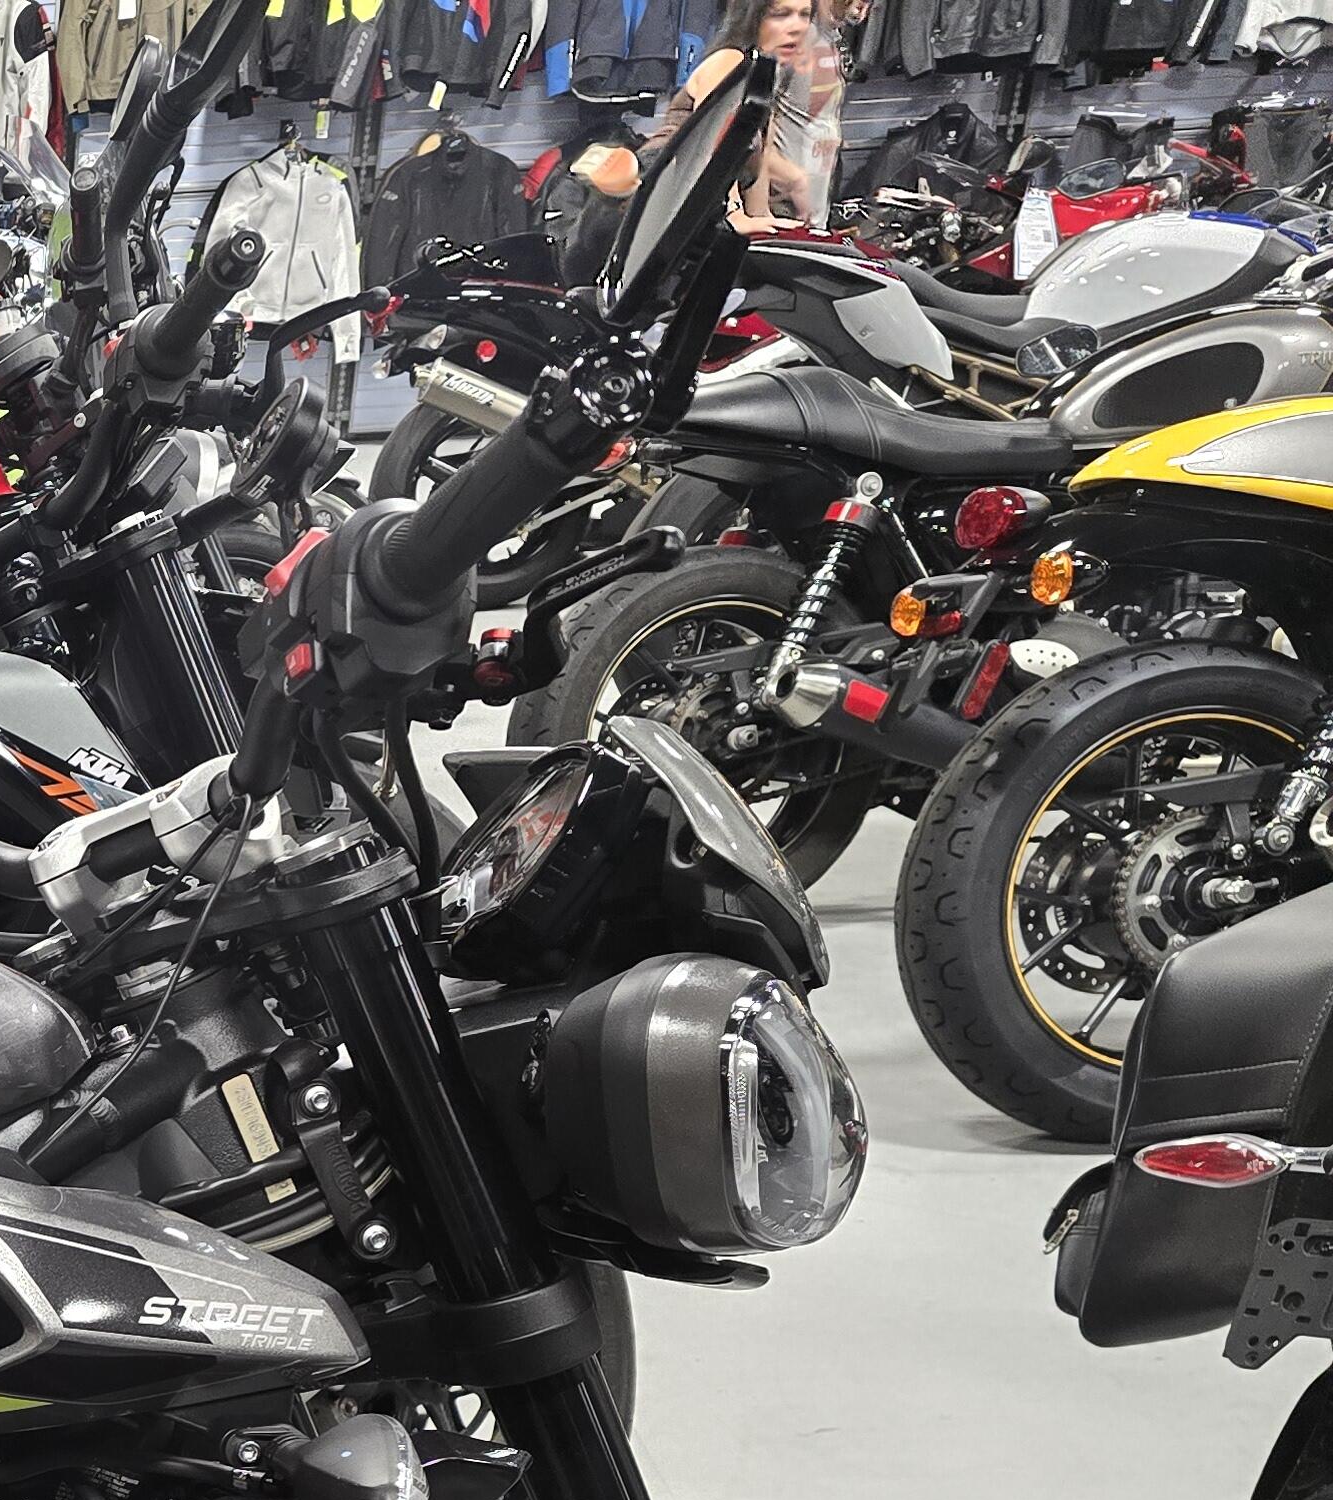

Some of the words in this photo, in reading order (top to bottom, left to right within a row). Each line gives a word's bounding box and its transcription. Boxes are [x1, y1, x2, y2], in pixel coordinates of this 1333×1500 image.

[67, 749, 132, 790] KTM
[138, 1297, 324, 1335] STREET
[240, 1333, 315, 1351] TRIPLE
